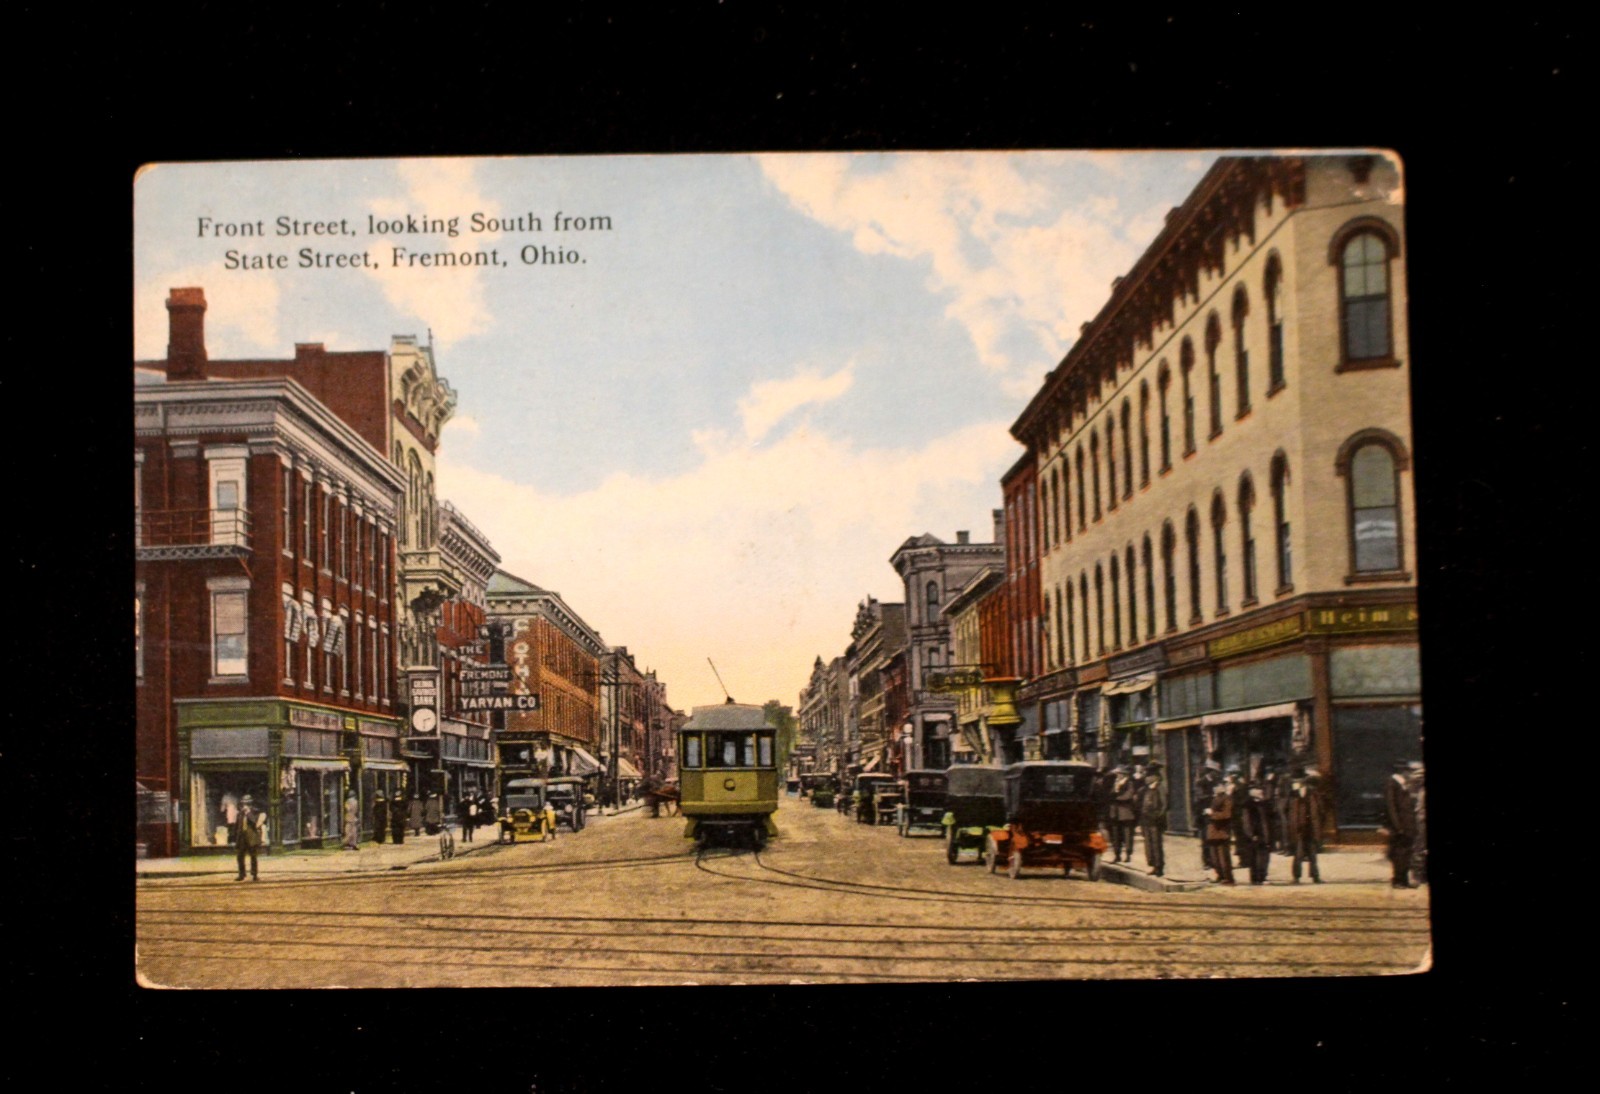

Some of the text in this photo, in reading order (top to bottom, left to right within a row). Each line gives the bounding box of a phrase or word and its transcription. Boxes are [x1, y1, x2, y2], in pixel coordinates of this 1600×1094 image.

[1320, 607, 1389, 625] Heim
[459, 645, 485, 655] THE
[516, 696, 537, 709] CO
